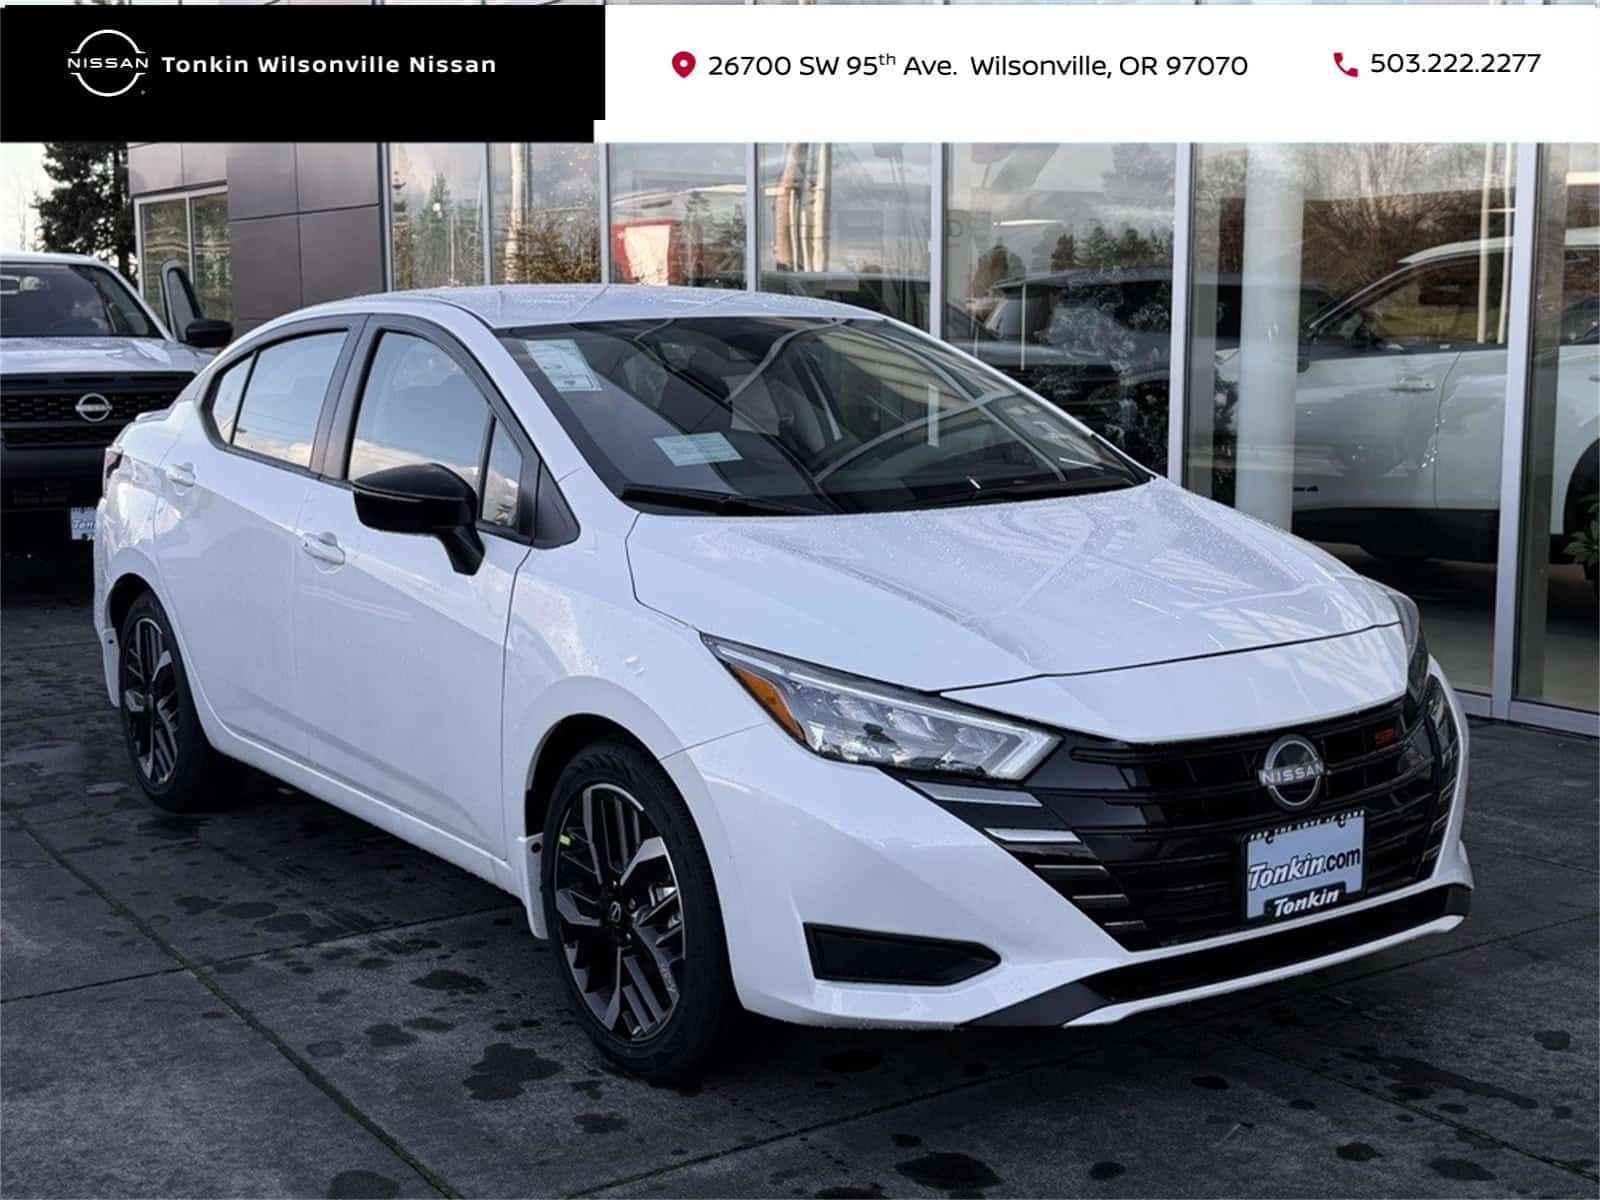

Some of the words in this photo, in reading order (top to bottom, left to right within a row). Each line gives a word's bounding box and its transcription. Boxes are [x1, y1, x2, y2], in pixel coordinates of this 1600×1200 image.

[1262, 761, 1325, 785] NISSAN
[1248, 848, 1361, 891] Tonkin.com
[1273, 888, 1340, 917] Tonkin
